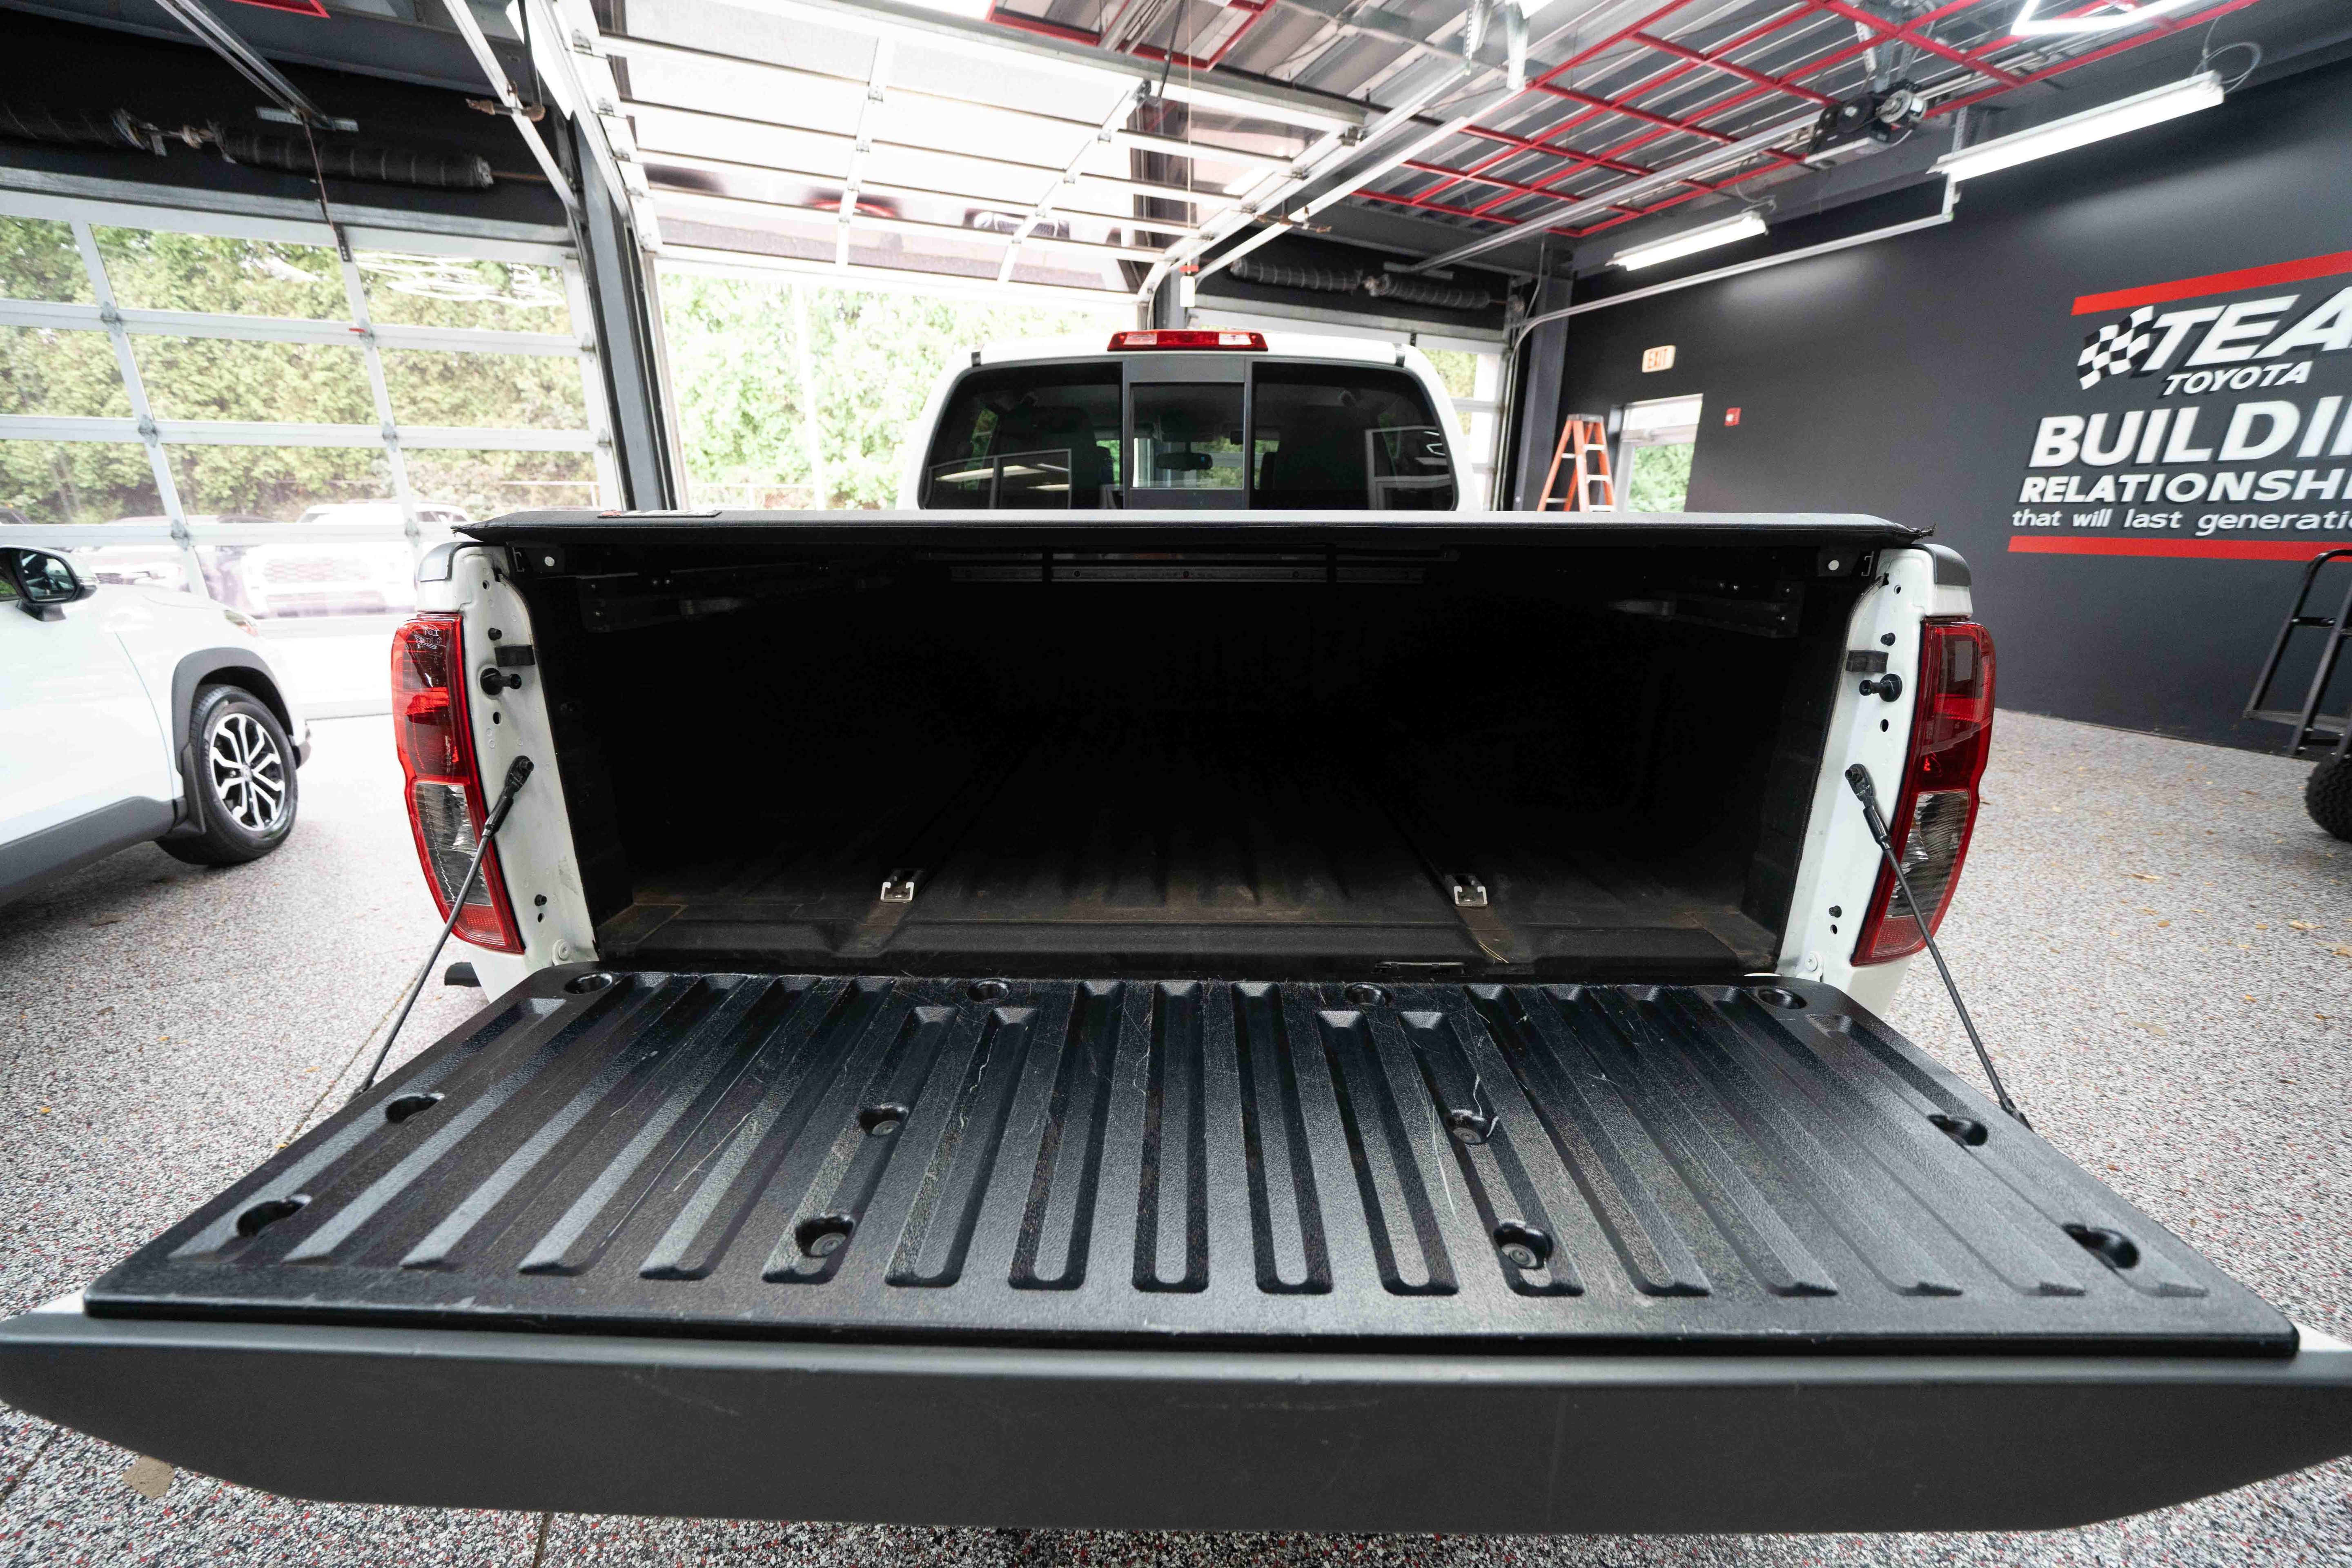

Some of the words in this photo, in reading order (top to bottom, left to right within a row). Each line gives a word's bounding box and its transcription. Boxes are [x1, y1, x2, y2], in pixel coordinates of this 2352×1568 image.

[2140, 285, 2352, 372] TEA
[1647, 348, 1668, 369] EXIT
[2163, 360, 2313, 395] TOYOTA
[2011, 508, 2062, 527] that
[2072, 508, 2113, 527] will
[2124, 508, 2183, 528] last
[2195, 510, 2352, 536] generati
